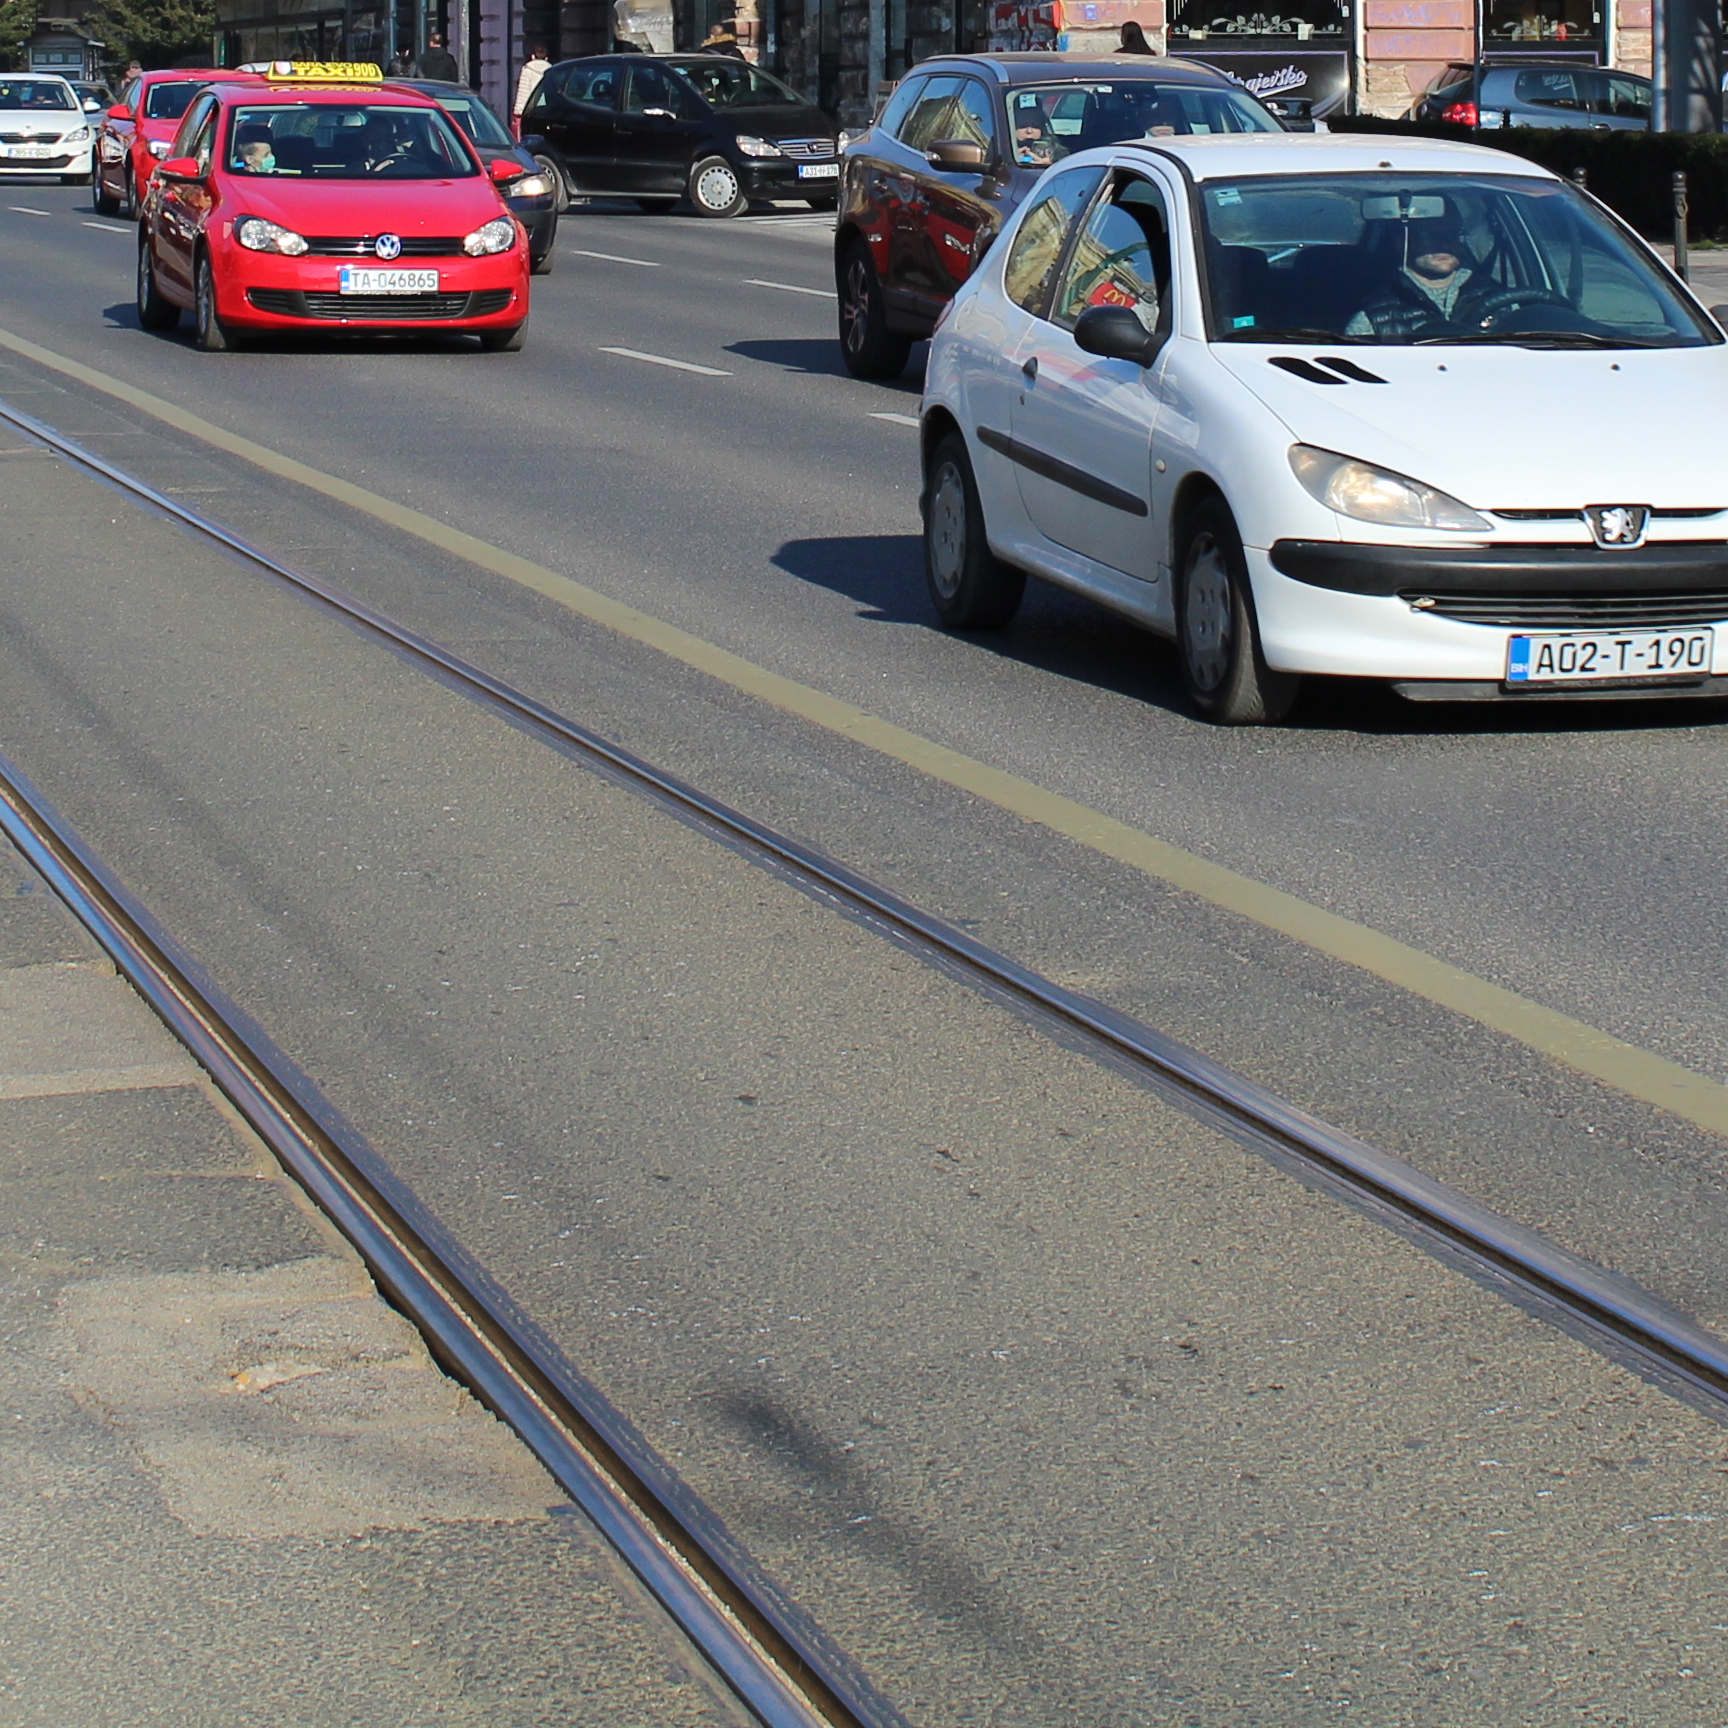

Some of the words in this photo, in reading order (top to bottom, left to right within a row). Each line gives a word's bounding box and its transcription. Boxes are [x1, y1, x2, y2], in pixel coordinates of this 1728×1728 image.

[292, 66, 353, 77] TAXI
[353, 62, 376, 77] 906
[351, 272, 436, 288] TA-046865
[1535, 636, 1706, 674] A02-T-190
